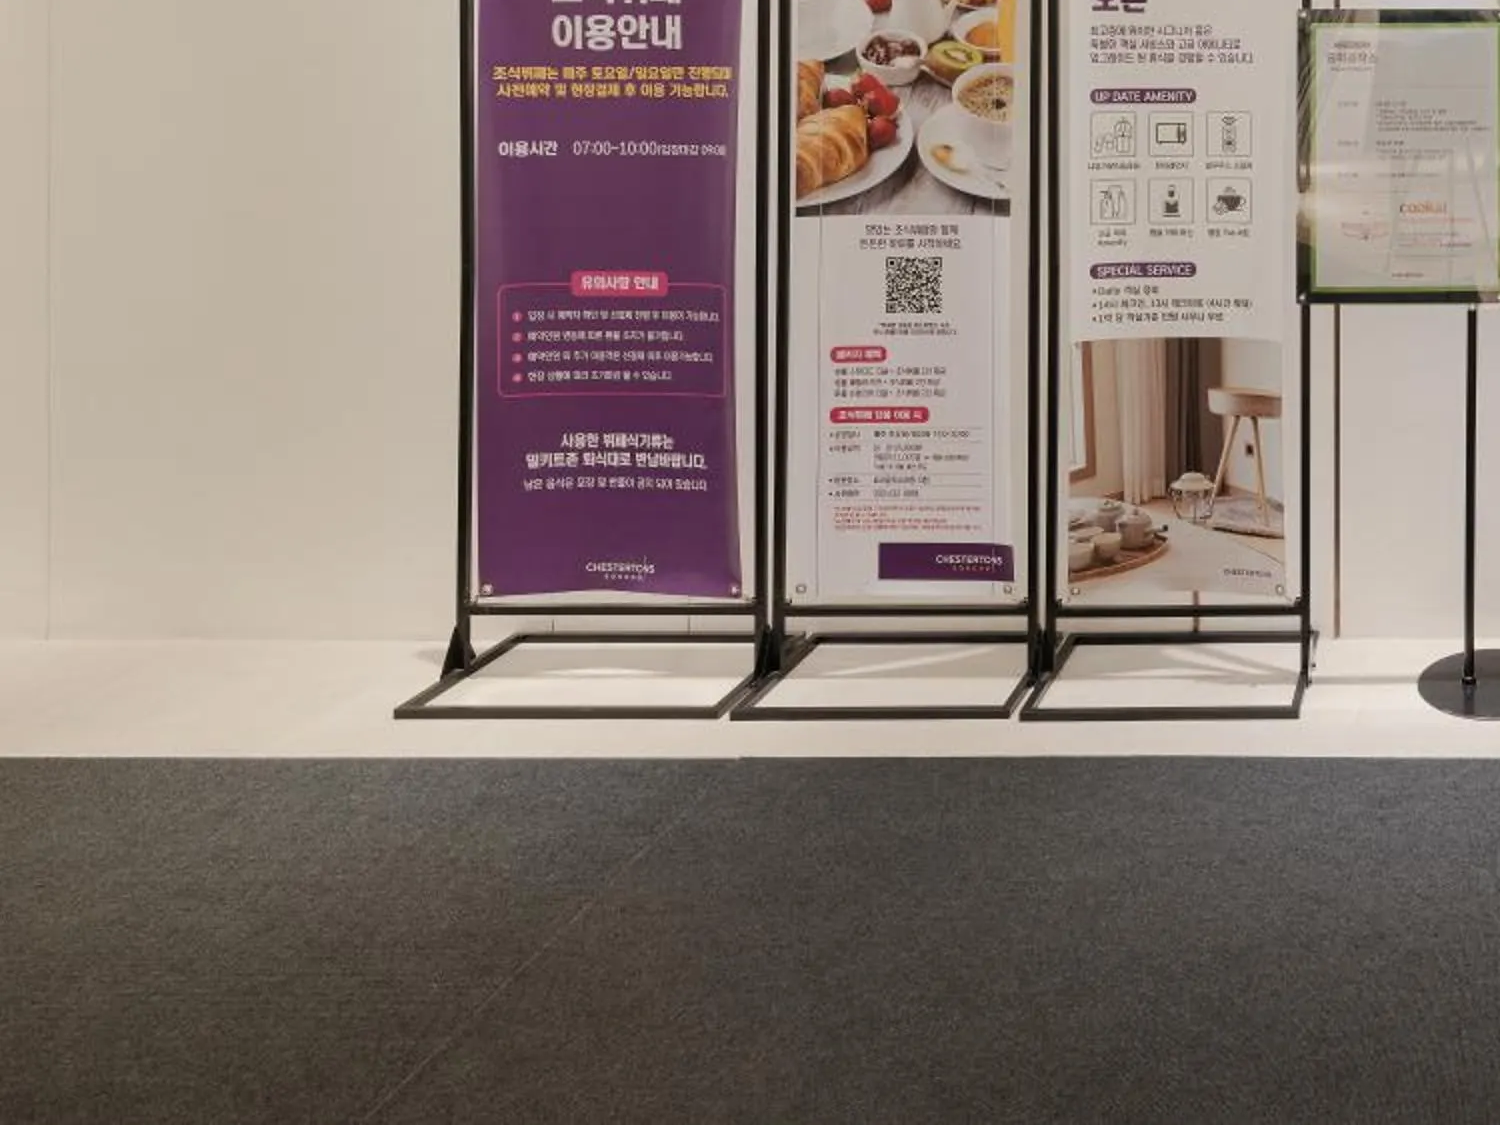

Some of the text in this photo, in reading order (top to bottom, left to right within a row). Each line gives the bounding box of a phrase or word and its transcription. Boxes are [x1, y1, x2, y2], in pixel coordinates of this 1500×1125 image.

[551, 15, 683, 51] 이용안내
[492, 66, 559, 80] 조식뷔페는
[562, 66, 587, 80] 매주
[496, 83, 551, 98] 사전예약
[624, 83, 636, 98] 후
[641, 83, 665, 98] 이용
[1094, 91, 1194, 103] UP DATE AMENITY
[497, 140, 558, 157] 이용시간
[1097, 264, 1192, 276] SPECIAL SERVICE
[581, 274, 659, 290] 유의사항 안내
[560, 432, 599, 449] 사용한
